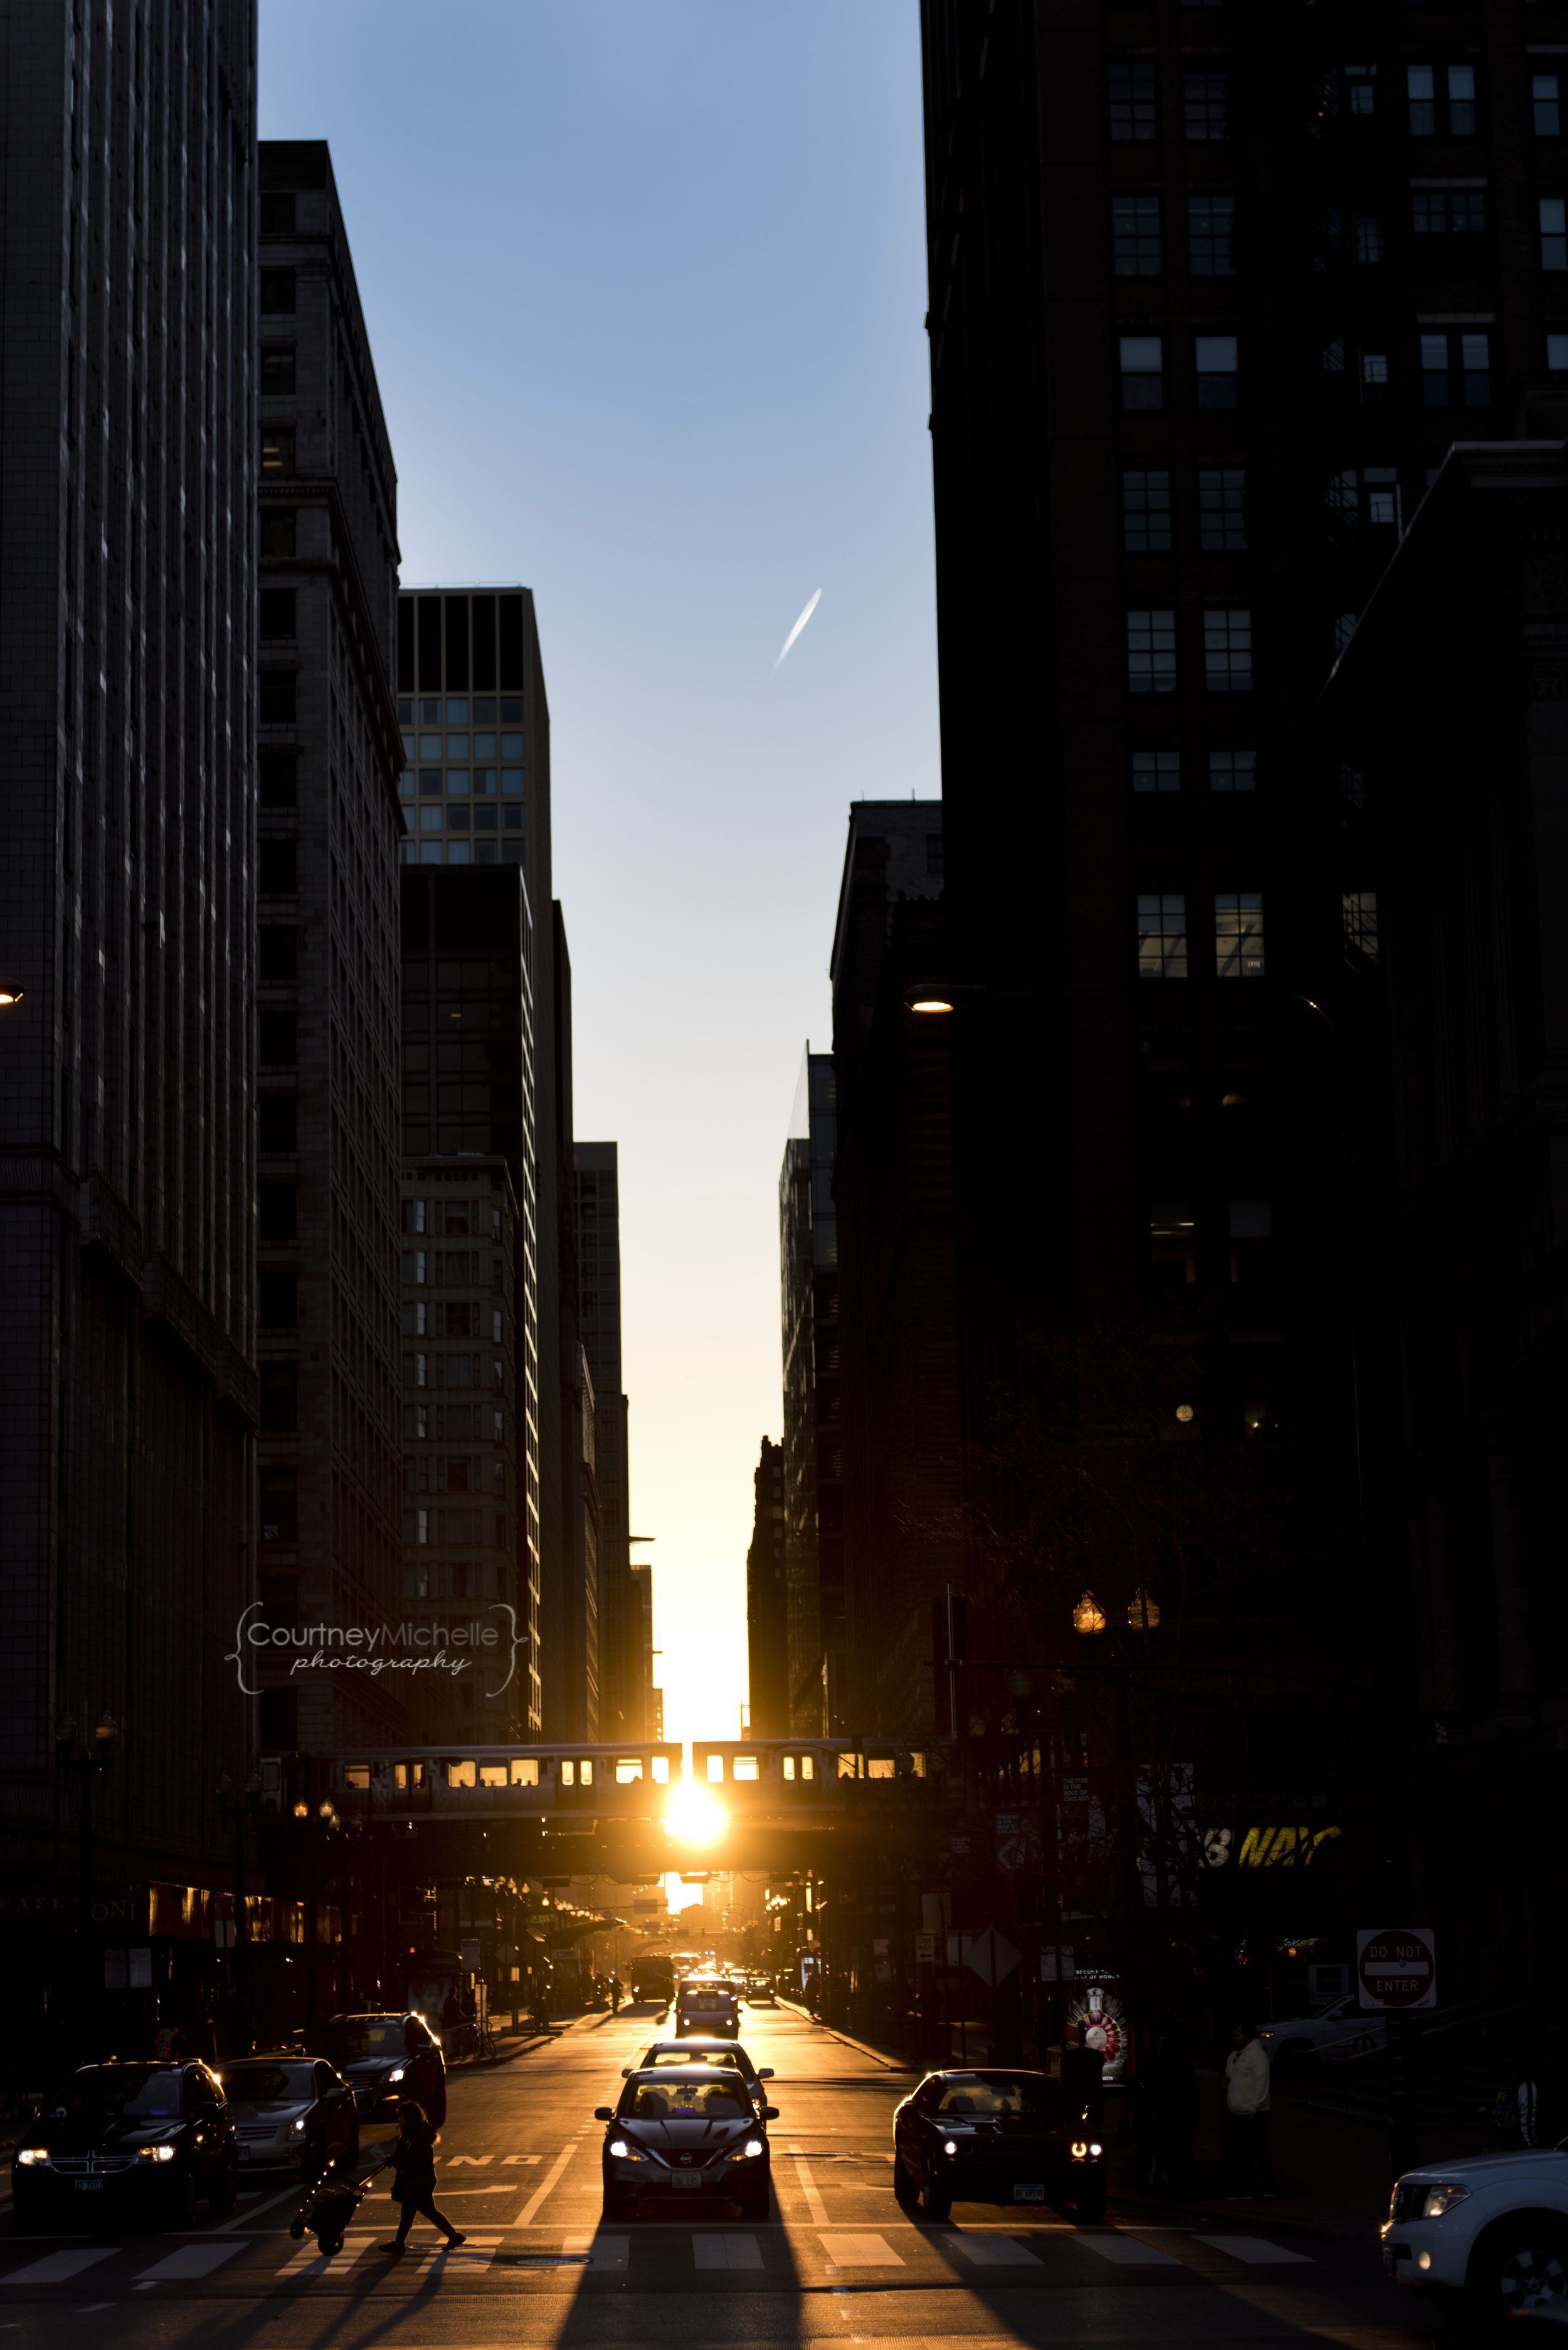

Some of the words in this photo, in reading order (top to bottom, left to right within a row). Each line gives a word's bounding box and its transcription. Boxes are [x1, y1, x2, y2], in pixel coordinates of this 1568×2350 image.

[1369, 1946, 1387, 1957] DO
[1396, 1945, 1422, 1957] NOT
[1376, 1980, 1418, 1992] ENTER
